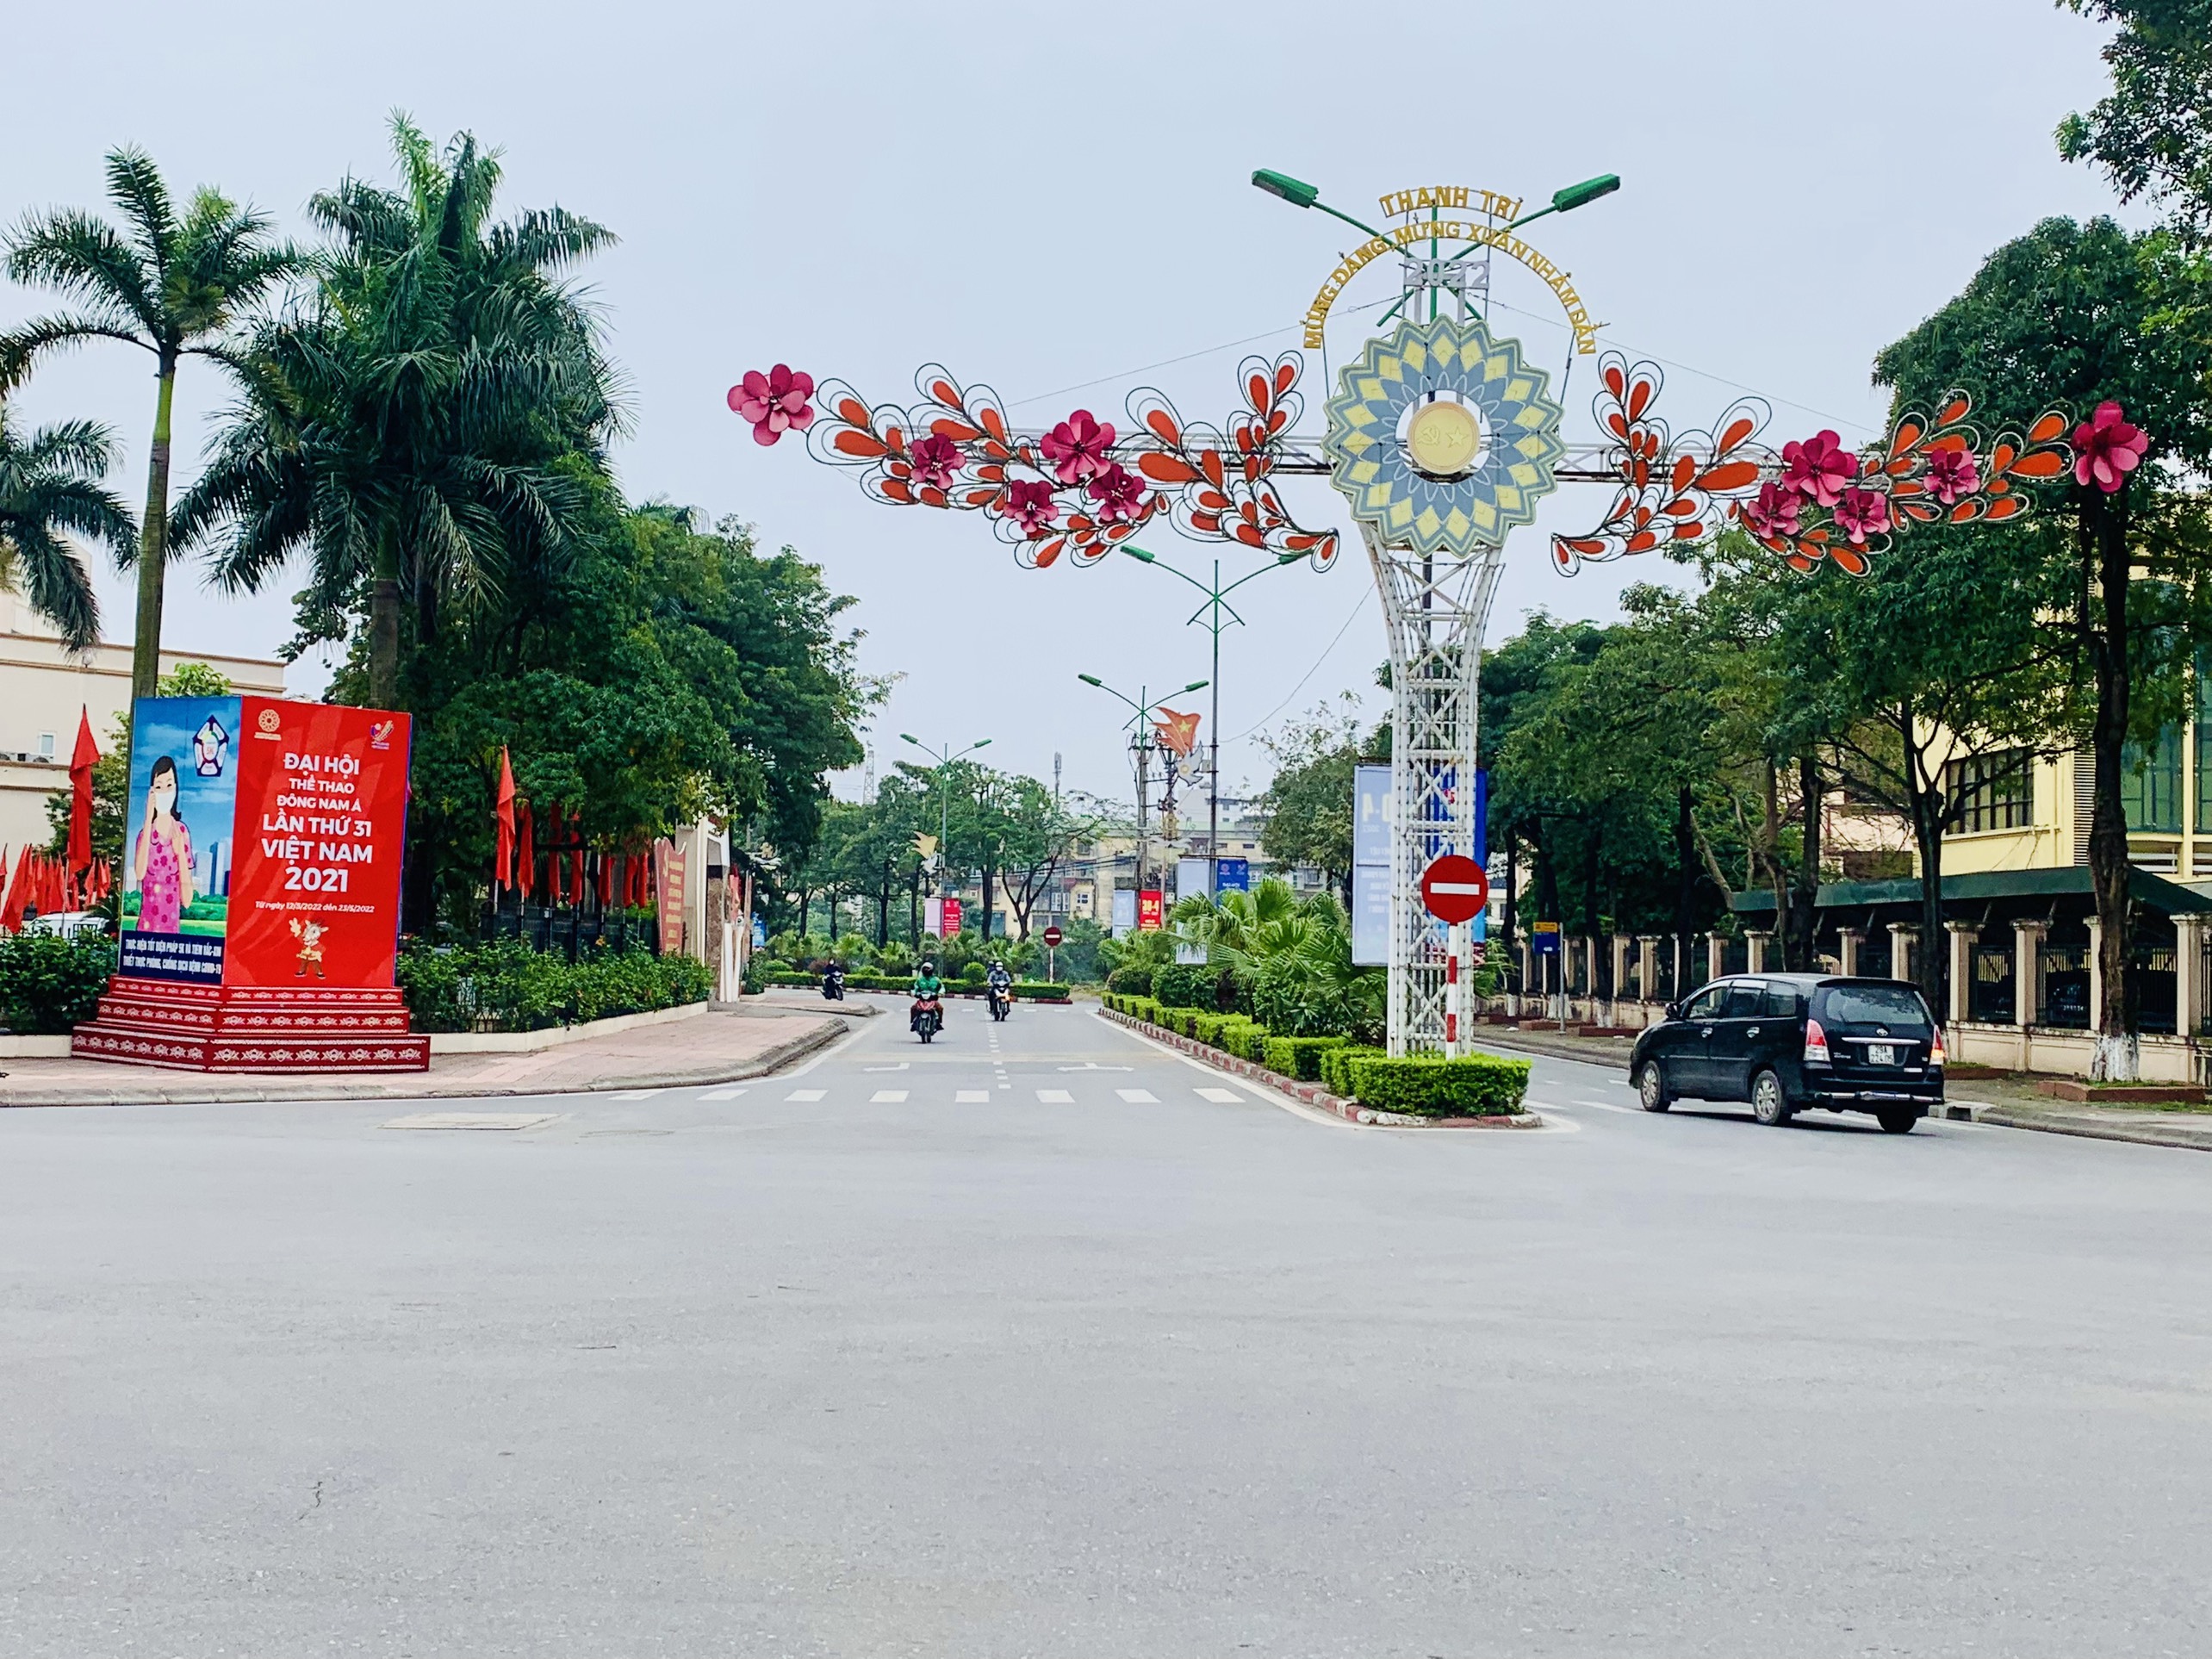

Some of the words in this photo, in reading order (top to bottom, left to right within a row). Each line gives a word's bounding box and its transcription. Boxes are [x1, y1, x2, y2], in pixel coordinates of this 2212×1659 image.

[1379, 185, 1469, 218] THANH
[1403, 258, 1490, 290] 2022
[283, 752, 320, 776] ĐẠI
[324, 754, 360, 780] HỘI
[289, 774, 316, 792] THỂ
[317, 780, 355, 795] THAO
[276, 793, 317, 810] ĐÔNG
[319, 798, 351, 811] NAM
[351, 798, 363, 813] Á
[262, 807, 304, 833] LẦN
[308, 815, 352, 836] THỨ
[352, 820, 372, 837] 31
[261, 835, 315, 866] VIỆT
[318, 842, 373, 864] NAM
[284, 866, 349, 892] 2021
[265, 901, 285, 910] ngày
